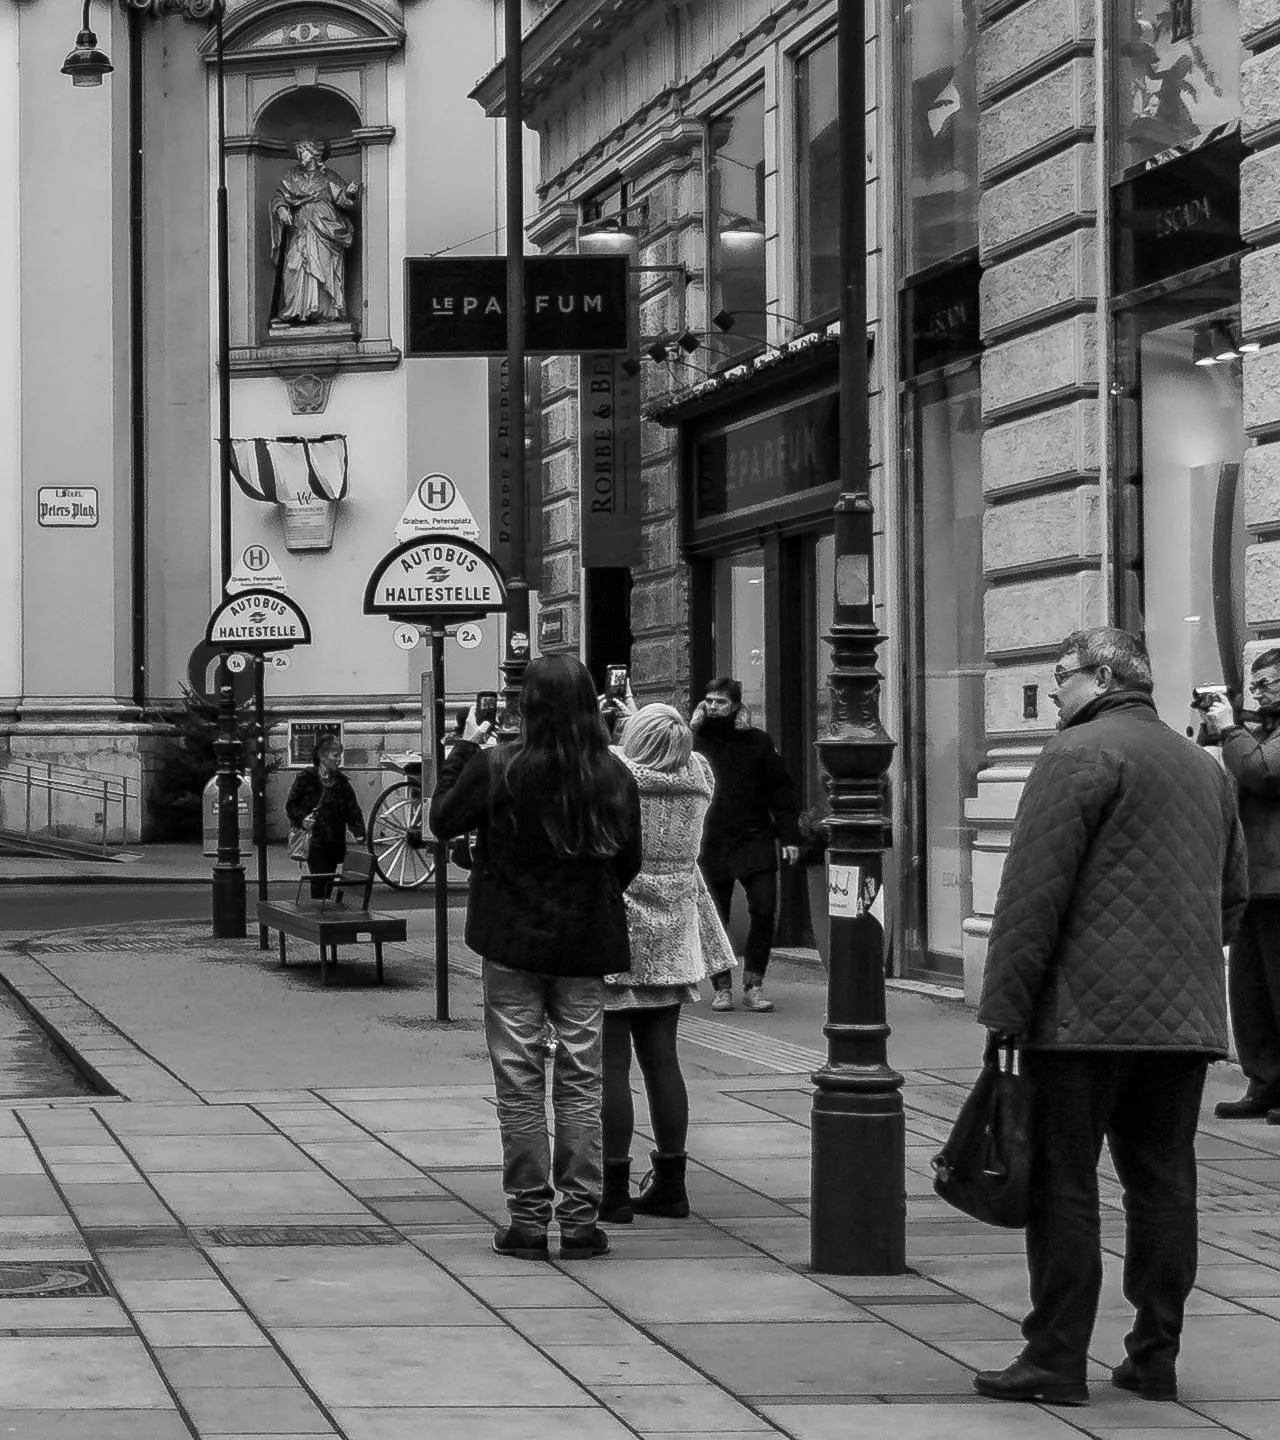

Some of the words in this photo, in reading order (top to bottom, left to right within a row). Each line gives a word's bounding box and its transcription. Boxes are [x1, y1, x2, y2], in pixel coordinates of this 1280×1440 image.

[432, 297, 454, 310] LE
[463, 295, 602, 315] PAFUM
[593, 403, 612, 419] &
[591, 429, 612, 514] ROBBE
[428, 482, 446, 503] H
[400, 546, 478, 573] AUTOBUS
[385, 587, 491, 602] HALTESTELLE
[230, 596, 287, 617] AUTOBUS
[220, 626, 296, 638] HALTESTELLE
[401, 633, 414, 644] 1A
[462, 630, 477, 642] 2A
